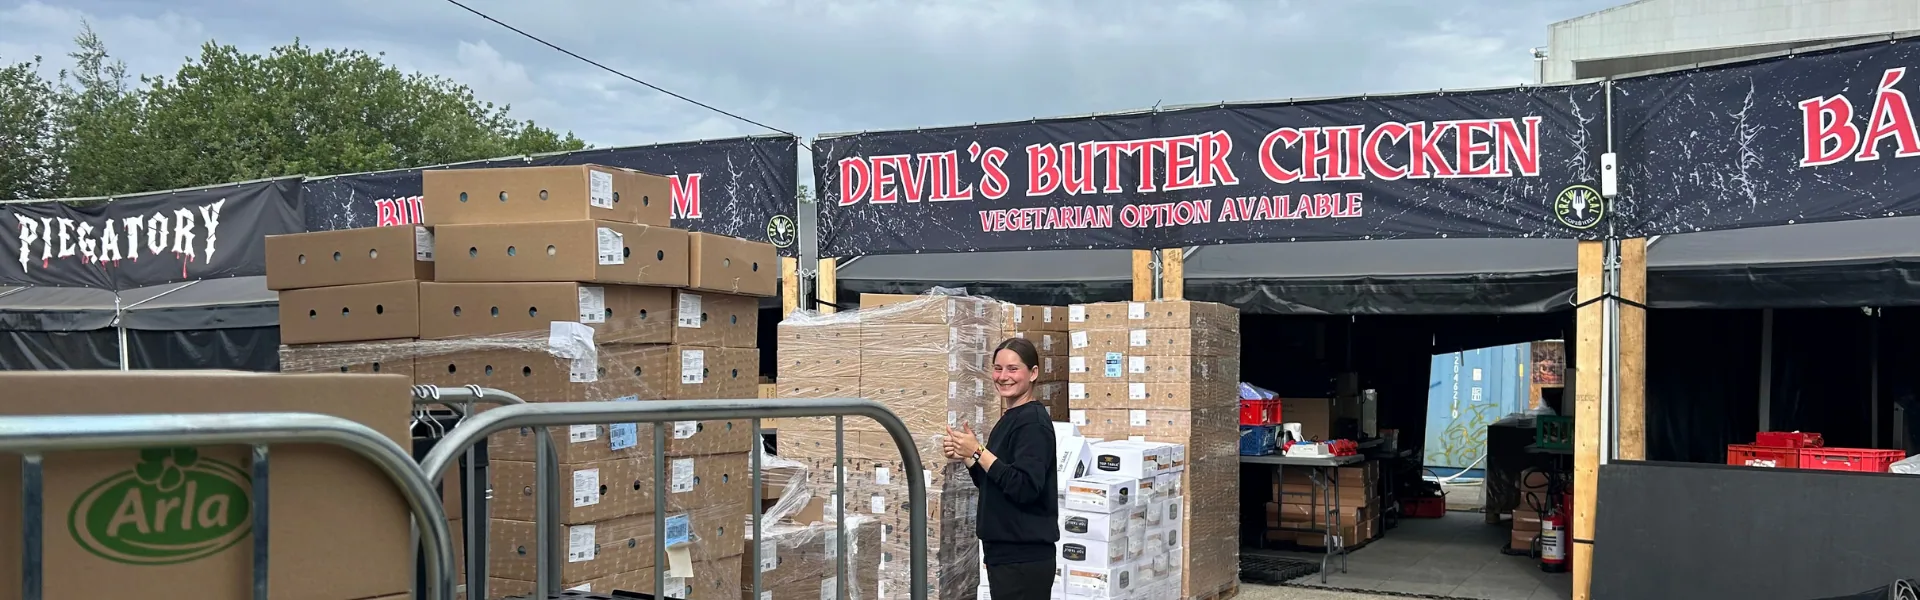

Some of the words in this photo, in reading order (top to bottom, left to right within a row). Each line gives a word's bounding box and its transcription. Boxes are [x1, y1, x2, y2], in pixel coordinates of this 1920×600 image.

[1798, 66, 1920, 167] BÁ
[838, 141, 1009, 206] DEVIL'S
[1026, 130, 1239, 196] BUTTER
[1259, 116, 1542, 183] CHICKEN
[375, 196, 424, 227] BU
[664, 173, 702, 219] M
[979, 206, 1113, 232] VEGETARIAN
[1119, 200, 1211, 228] OPTION
[1218, 193, 1363, 222] AVAILABLE
[1558, 190, 1574, 215] CREW
[1584, 190, 1600, 213] MEAL
[14, 198, 226, 274] PIEGATORY
[1452, 351, 1460, 419] 2046210
[106, 480, 229, 537] Arla
